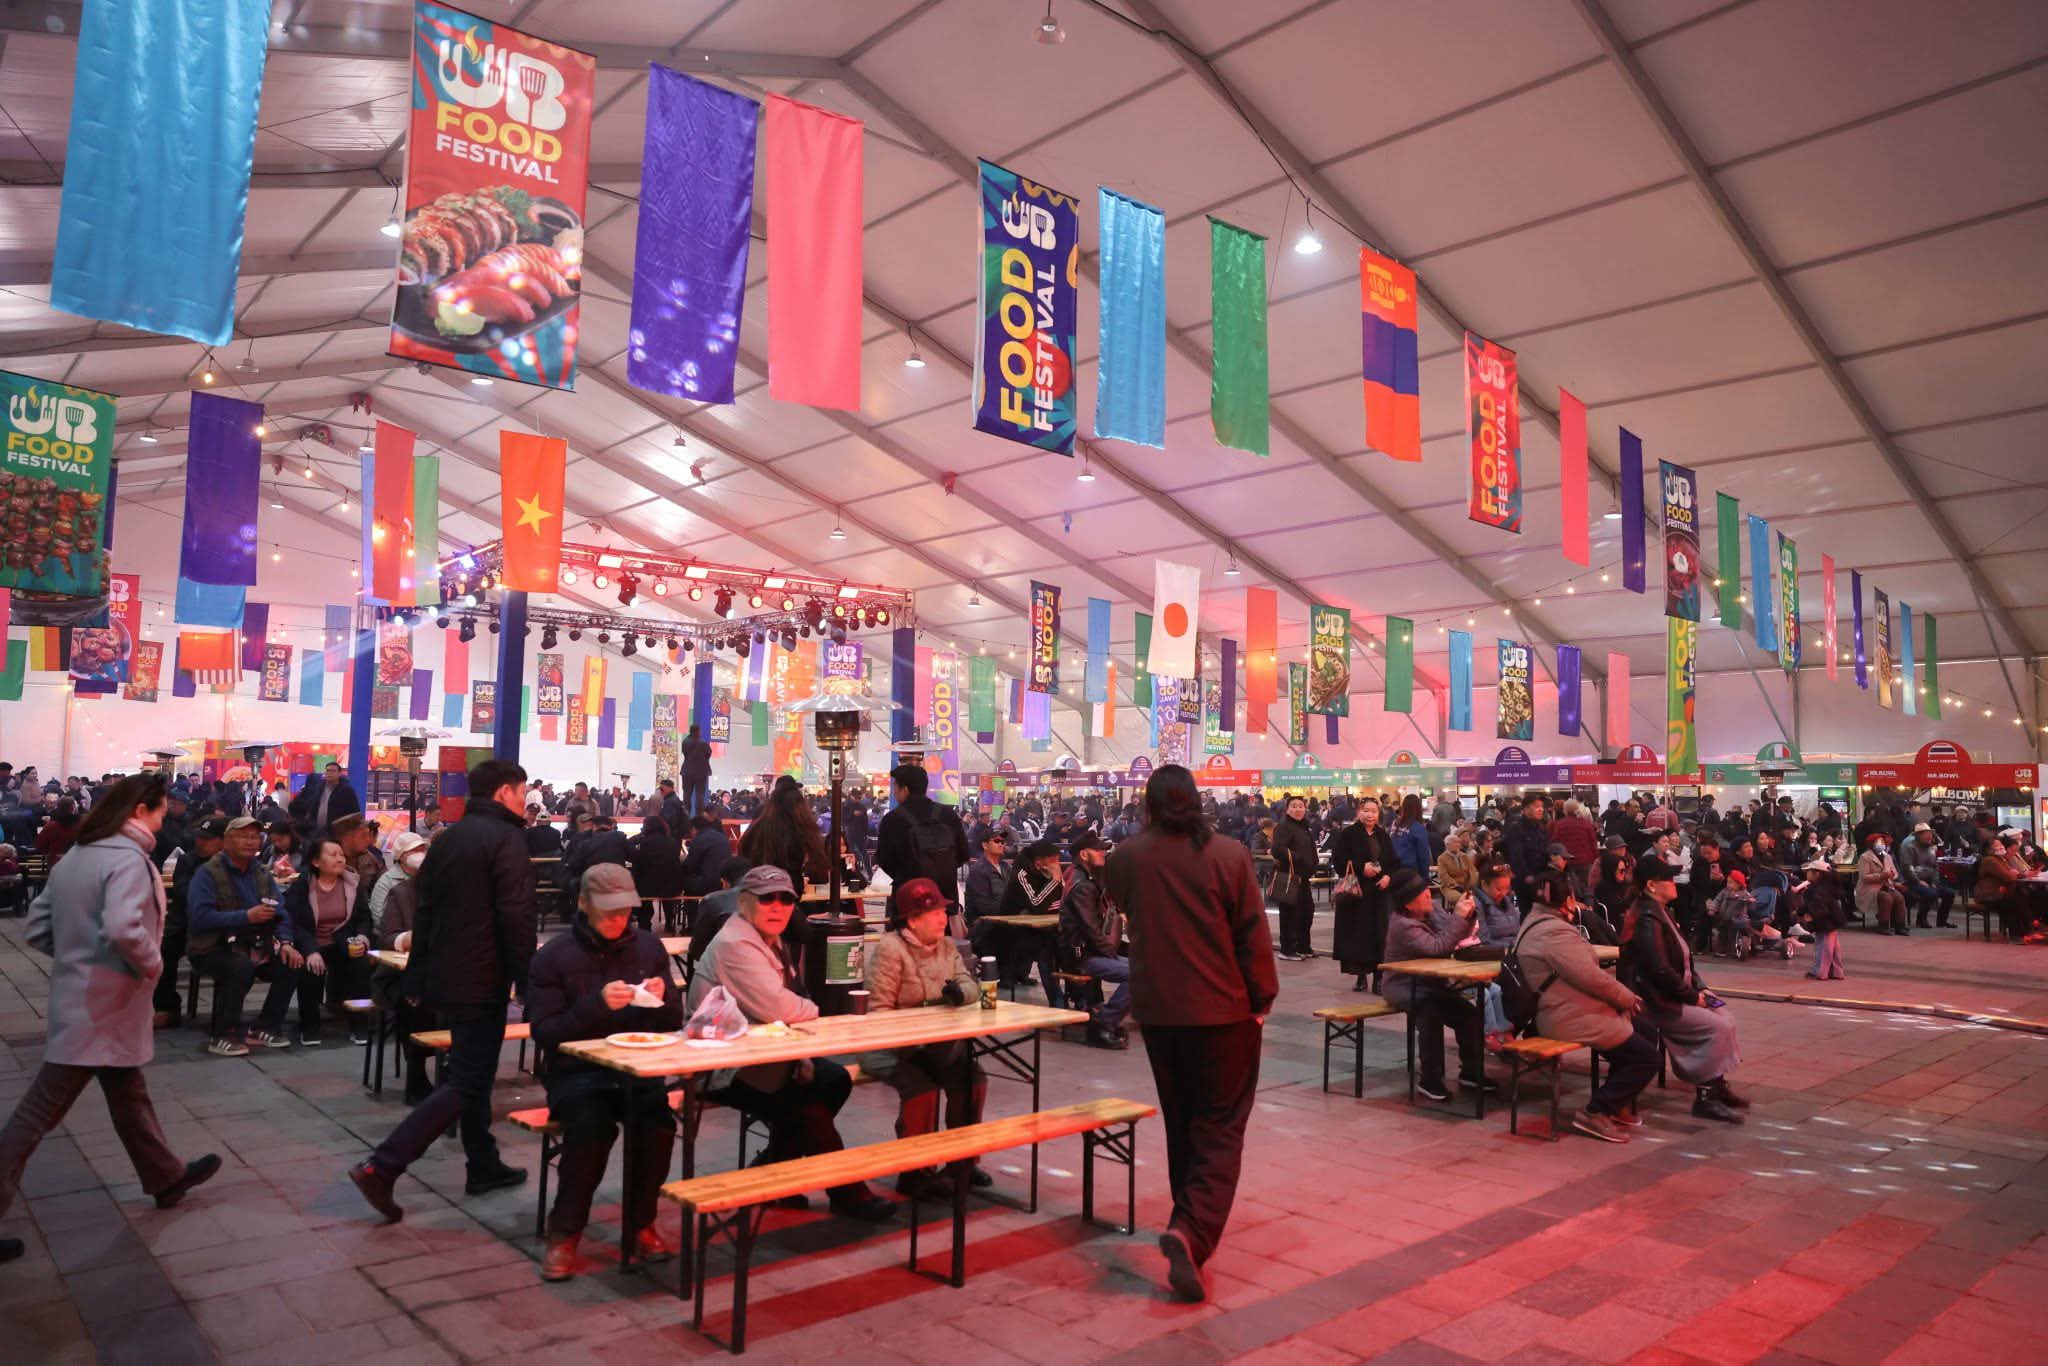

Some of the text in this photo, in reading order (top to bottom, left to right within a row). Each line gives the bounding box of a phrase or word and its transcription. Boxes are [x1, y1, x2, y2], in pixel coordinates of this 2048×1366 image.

[438, 39, 567, 131] UB
[436, 101, 563, 163] FOOD
[436, 133, 560, 184] FESTIVAL
[1000, 247, 1035, 428] FOOD
[1033, 264, 1056, 432] FESTIVAL
[10, 395, 97, 444] UB
[8, 432, 94, 464] FOOD
[8, 451, 91, 476] FESTIVAL
[1479, 391, 1498, 516] FOOD
[1496, 399, 1509, 518] FESTIVAL
[1666, 503, 1692, 523] FOOD
[1666, 517, 1693, 533] FESTIVAL
[1035, 590, 1043, 660] FESTIVAL
[1043, 591, 1054, 663] FOOD
[1315, 634, 1344, 648] FOOD
[265, 659, 279, 698] FOOD
[828, 661, 857, 671] FOOD
[1503, 666, 1528, 678] FOOD
[539, 700, 562, 709] FOOD
[1180, 701, 1199, 713] FOOD
[570, 708, 579, 744] FOOD
[710, 729, 729, 737] FOOD
[1205, 736, 1232, 746] FOOD
